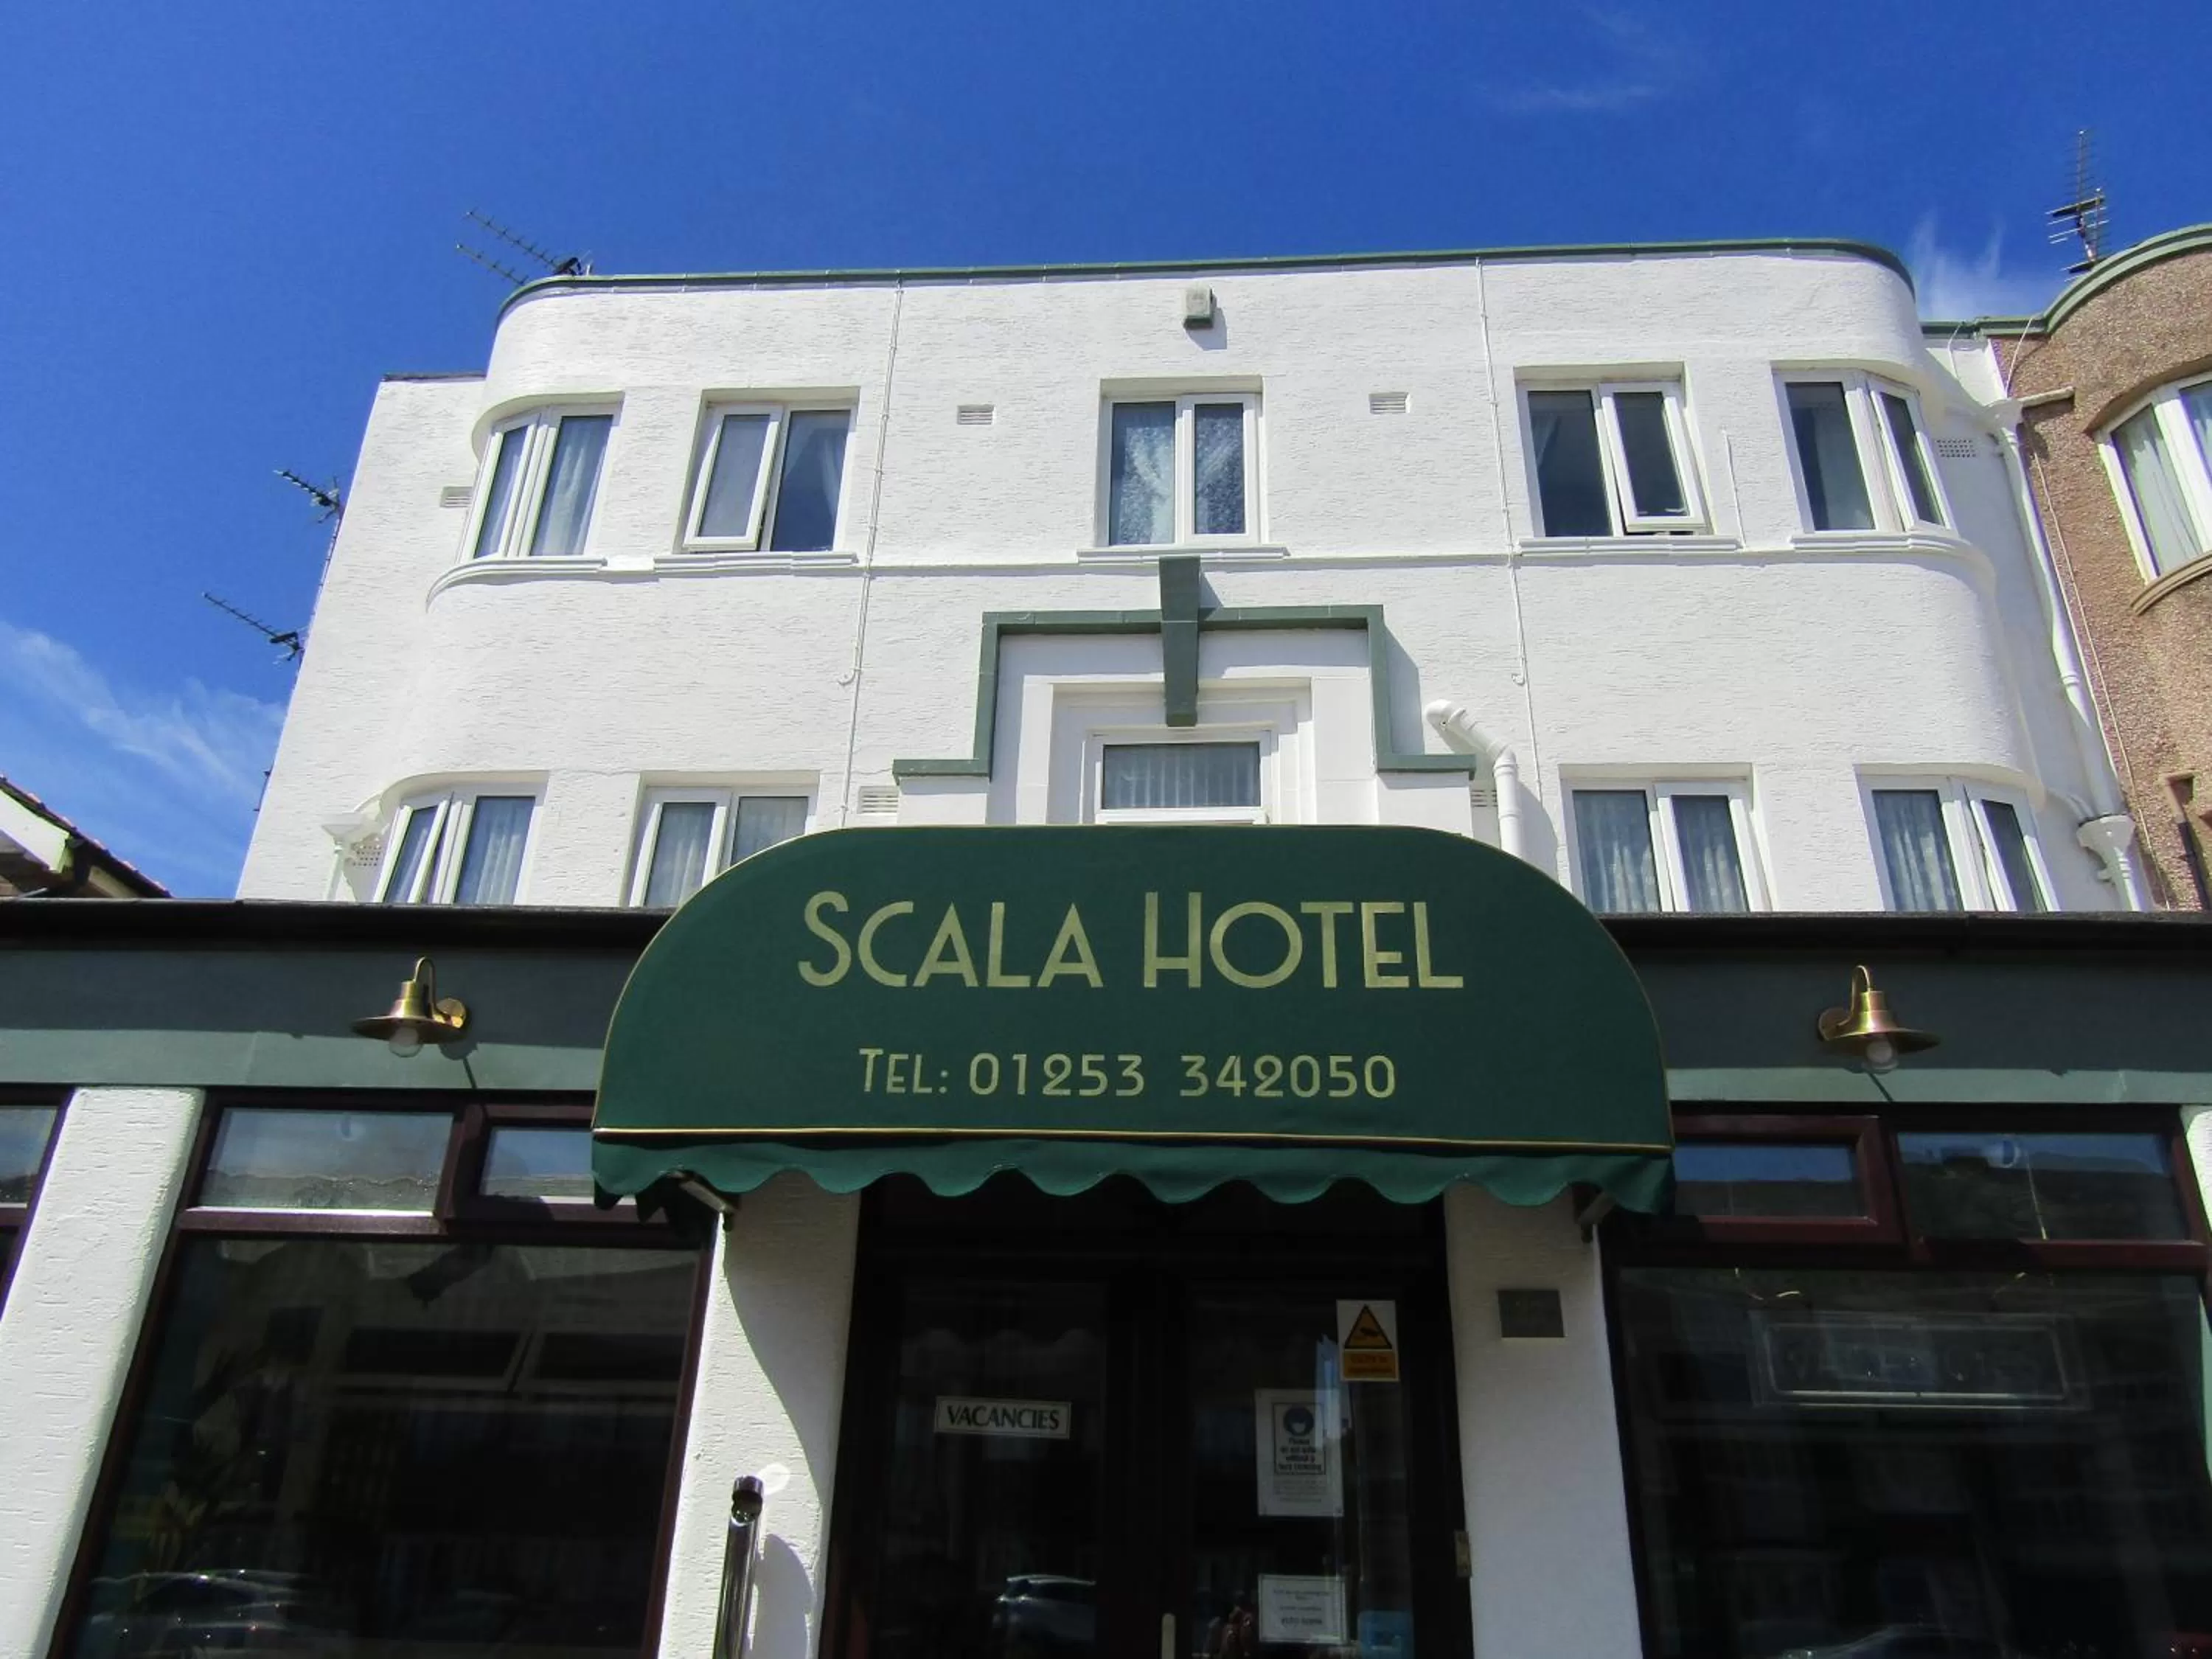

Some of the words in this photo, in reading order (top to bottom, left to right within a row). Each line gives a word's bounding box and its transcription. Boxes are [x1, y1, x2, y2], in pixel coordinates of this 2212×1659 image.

[799, 891, 1104, 987] SCALA
[1144, 892, 1464, 989] HOTEL
[859, 1048, 948, 1093] TEL:
[970, 1053, 1144, 1096] 01253
[1180, 1055, 1395, 1098] 342050
[946, 1405, 1060, 1430] VACANCIES
